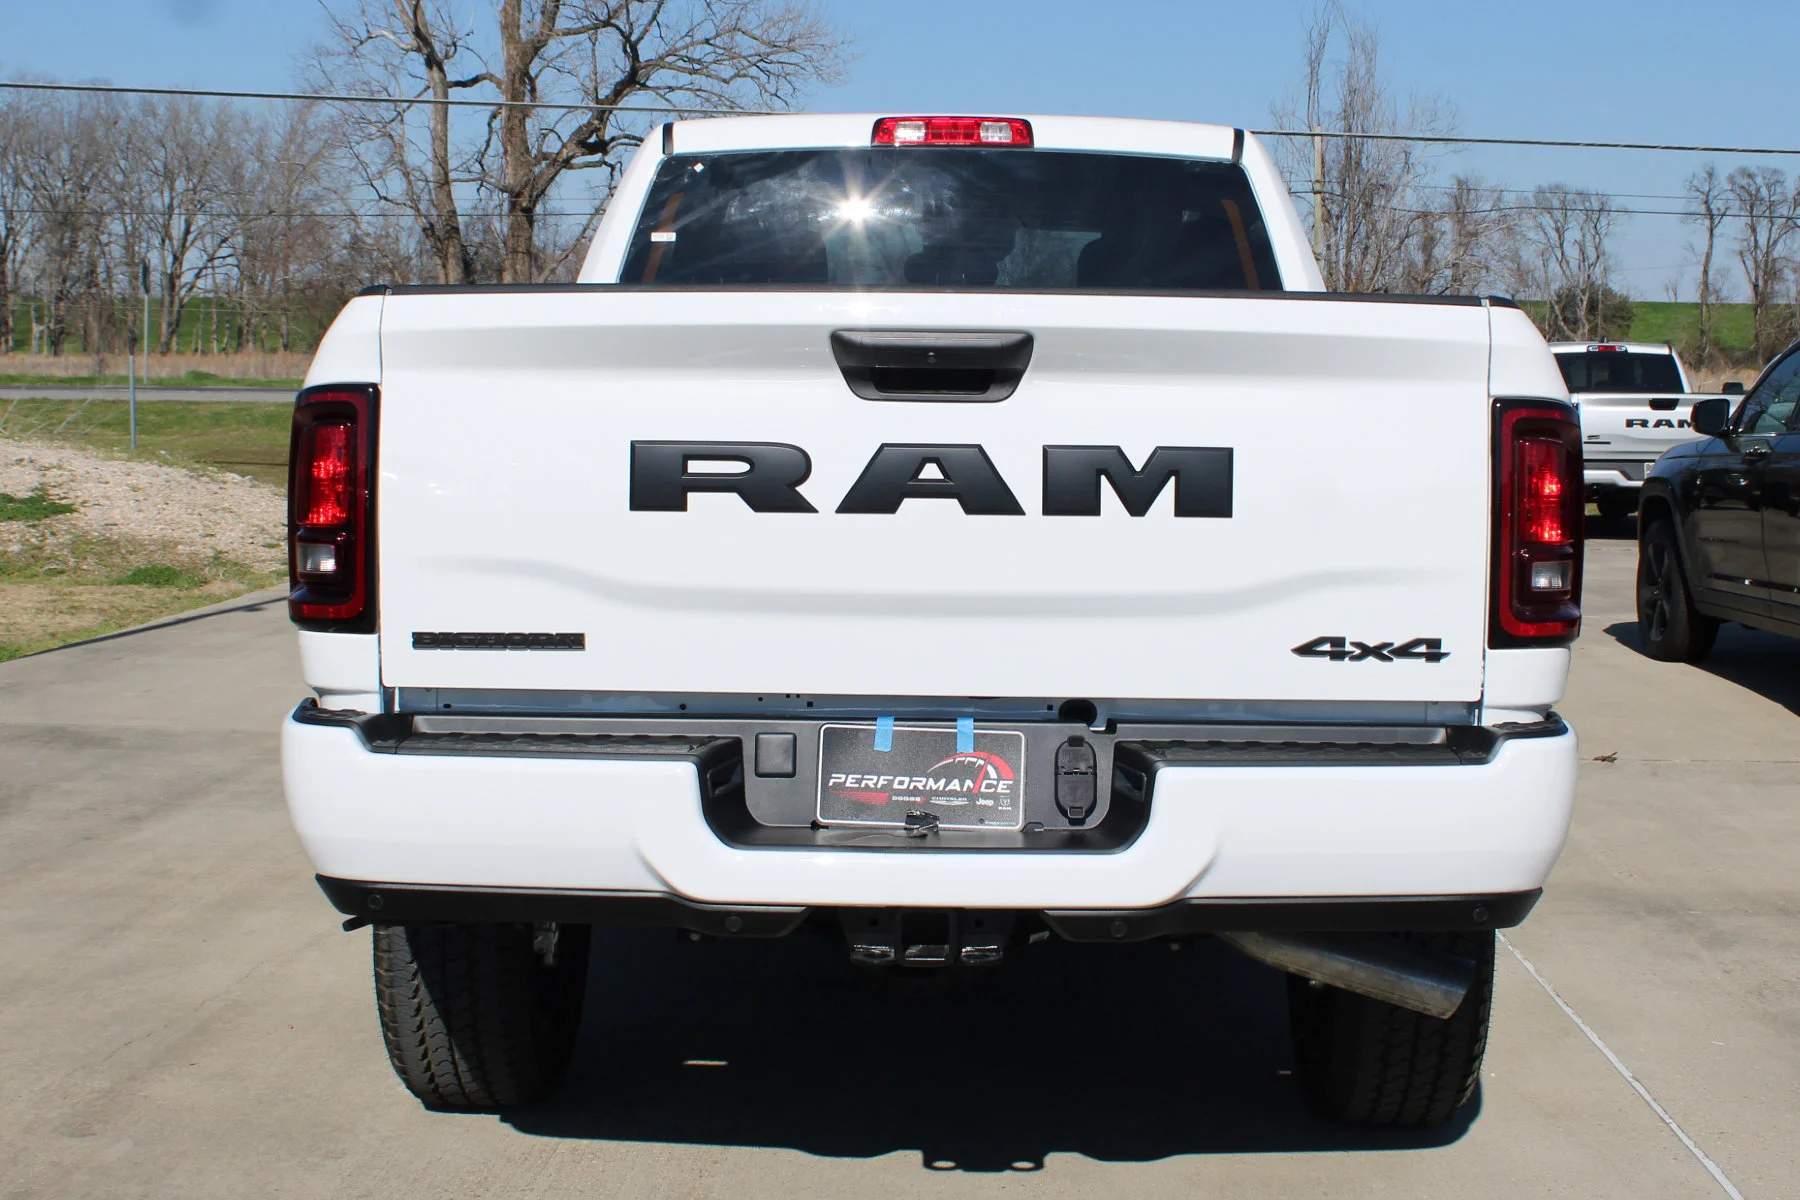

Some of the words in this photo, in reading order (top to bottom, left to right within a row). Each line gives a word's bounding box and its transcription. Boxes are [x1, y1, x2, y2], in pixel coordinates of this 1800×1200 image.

[1625, 418, 1694, 428] RAM
[629, 440, 1234, 518] RAM
[1290, 635, 1451, 663] 4x4
[828, 774, 1014, 793] PERFORMANCE
[976, 797, 994, 806] Jeep
